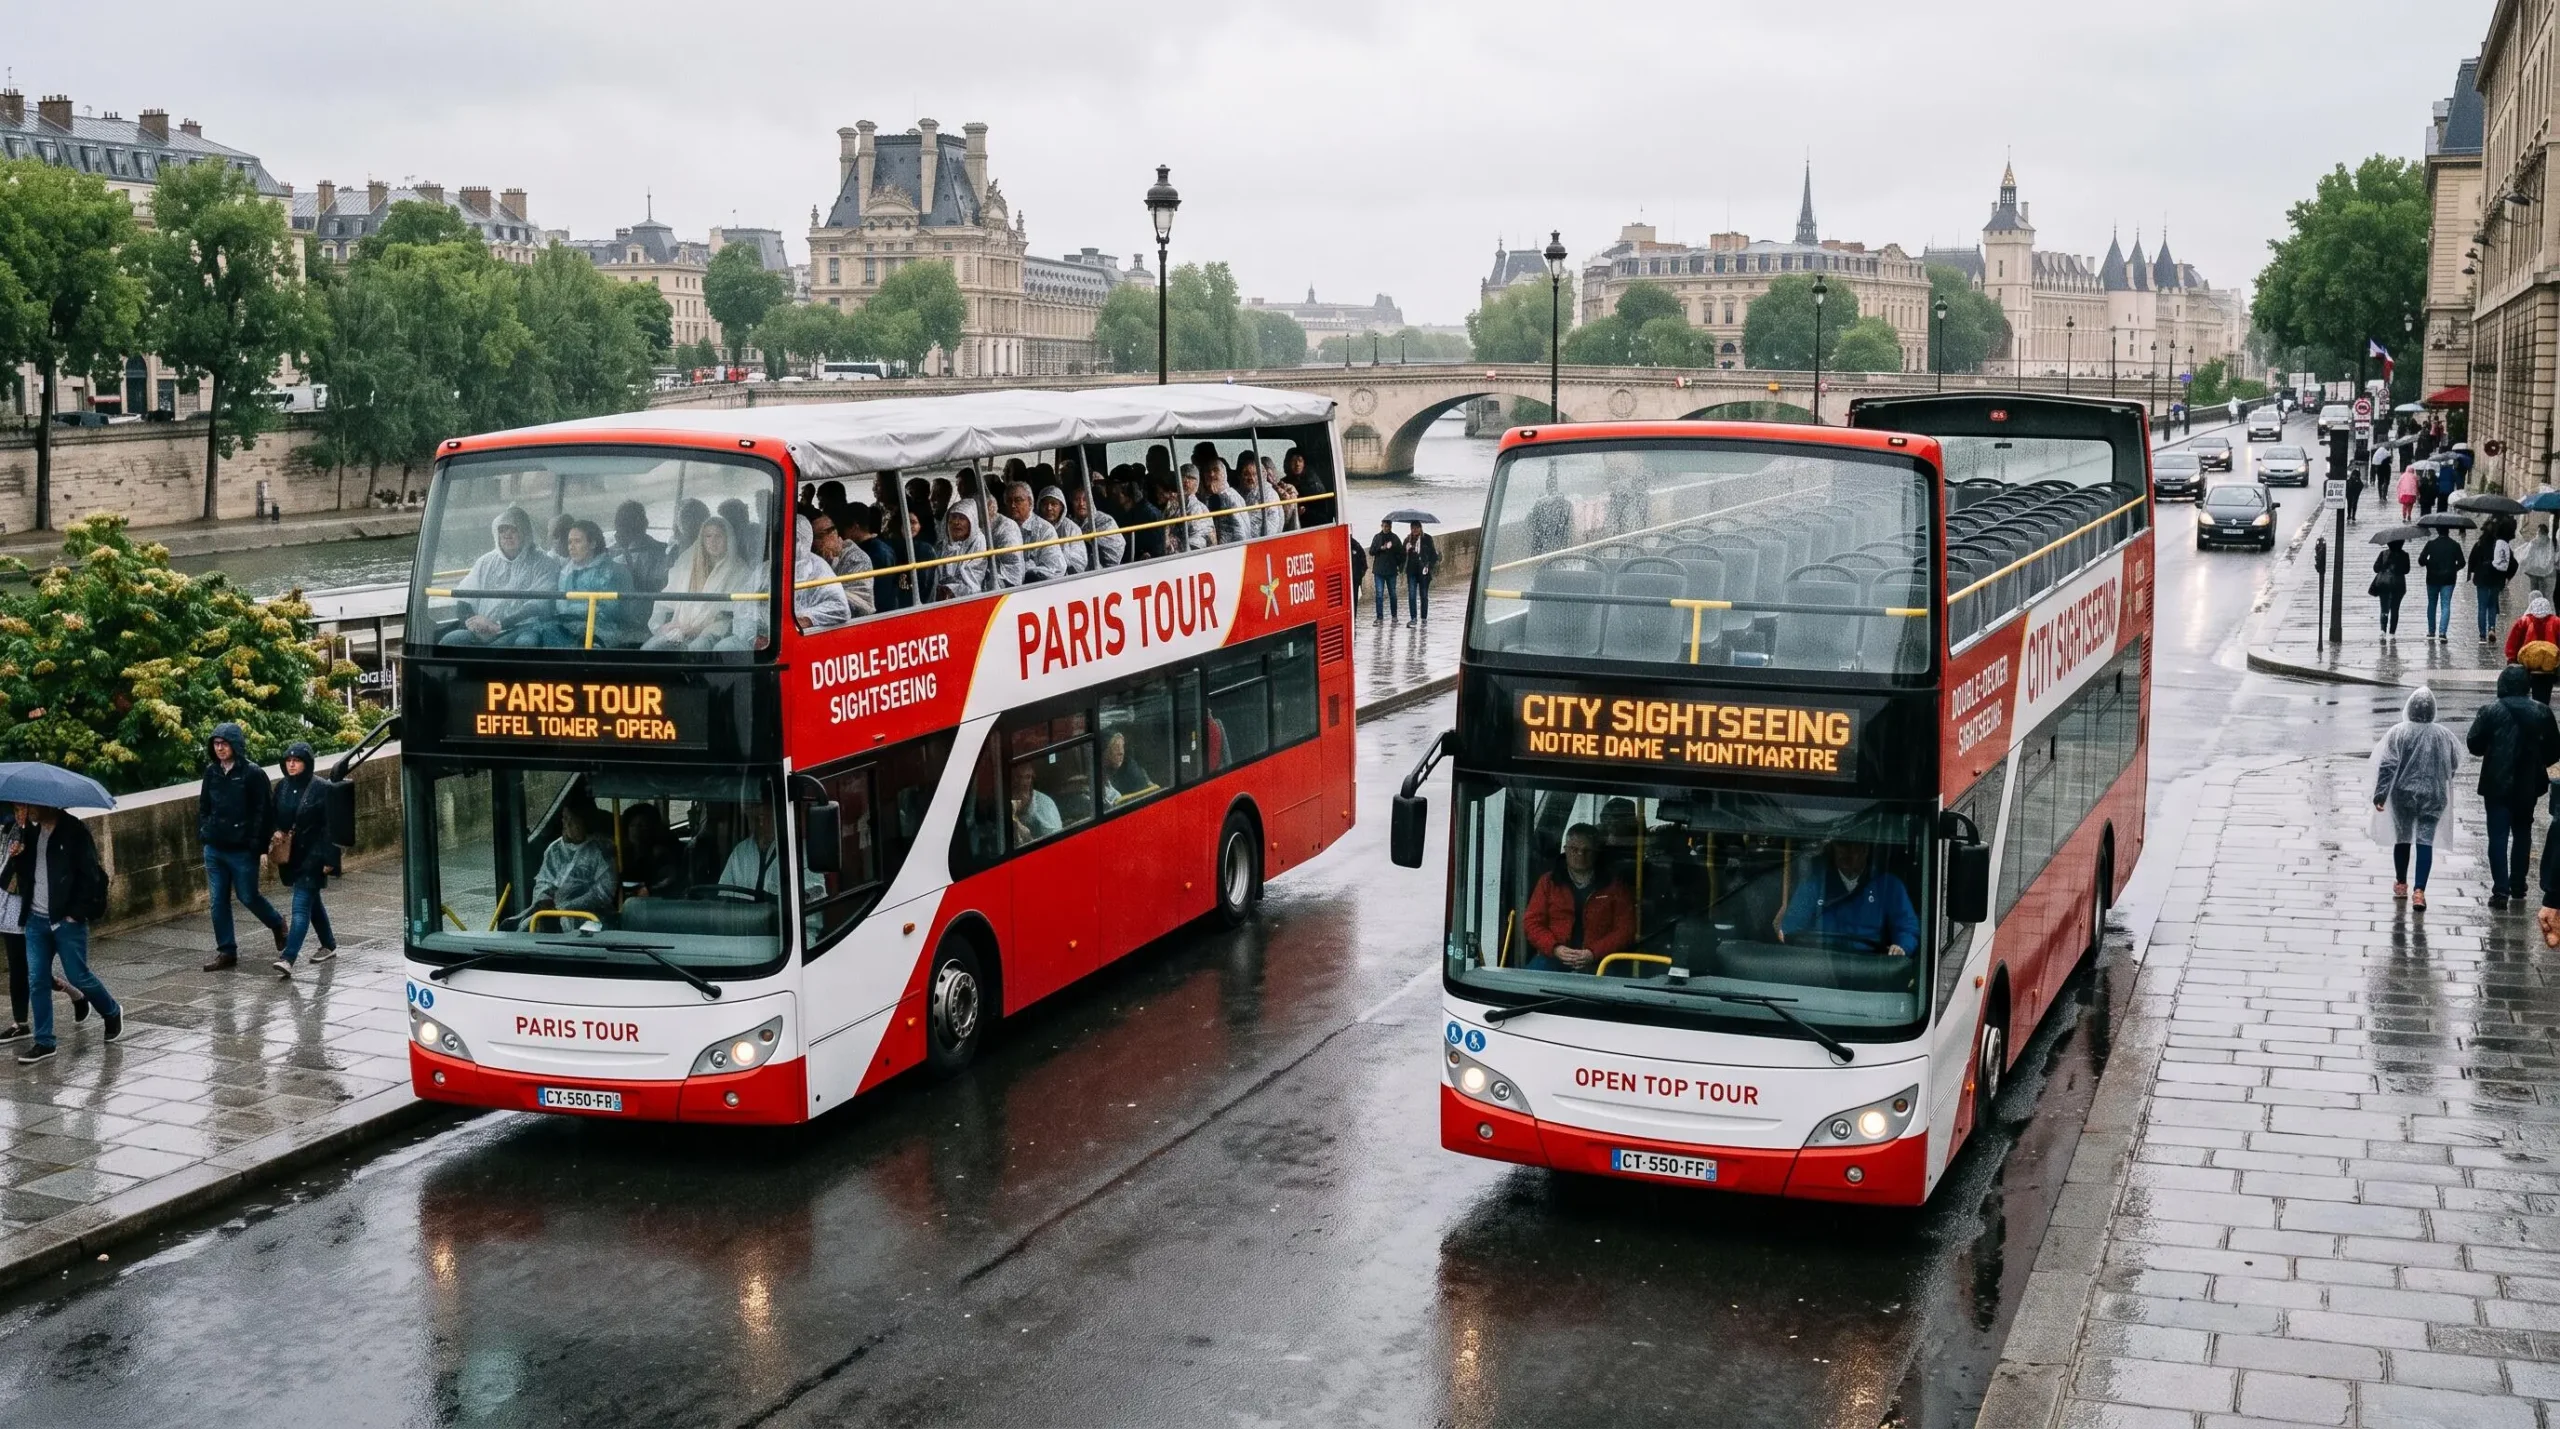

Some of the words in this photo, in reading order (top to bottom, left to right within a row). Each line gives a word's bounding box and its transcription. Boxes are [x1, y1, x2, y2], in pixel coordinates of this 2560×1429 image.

[1017, 592, 1125, 680] PARIS
[1133, 572, 1219, 647] TOUR
[2028, 619, 2054, 704] CITY
[2056, 576, 2116, 681] SIGHTSEEING
[811, 633, 949, 690] DOUBLE-DECKER
[488, 682, 575, 713] PARIS
[582, 684, 662, 715] TOUR
[830, 672, 937, 724] SIGHTSEEING
[1523, 694, 1602, 729] CITY
[1612, 700, 1850, 746] SIGHTSEEING
[476, 714, 533, 736] EIFFEL
[538, 716, 599, 738] TOWER
[616, 719, 677, 740] OPERA
[1530, 731, 1599, 756] NOTRE
[1605, 735, 1664, 760] DAME
[1686, 740, 1838, 772] MONTMARTRE
[516, 1016, 576, 1038] PARIS
[582, 1021, 639, 1042] TOUR
[1575, 1067, 1636, 1092] OPEN
[1644, 1075, 1688, 1098] TOP
[1696, 1081, 1759, 1106] TOUR
